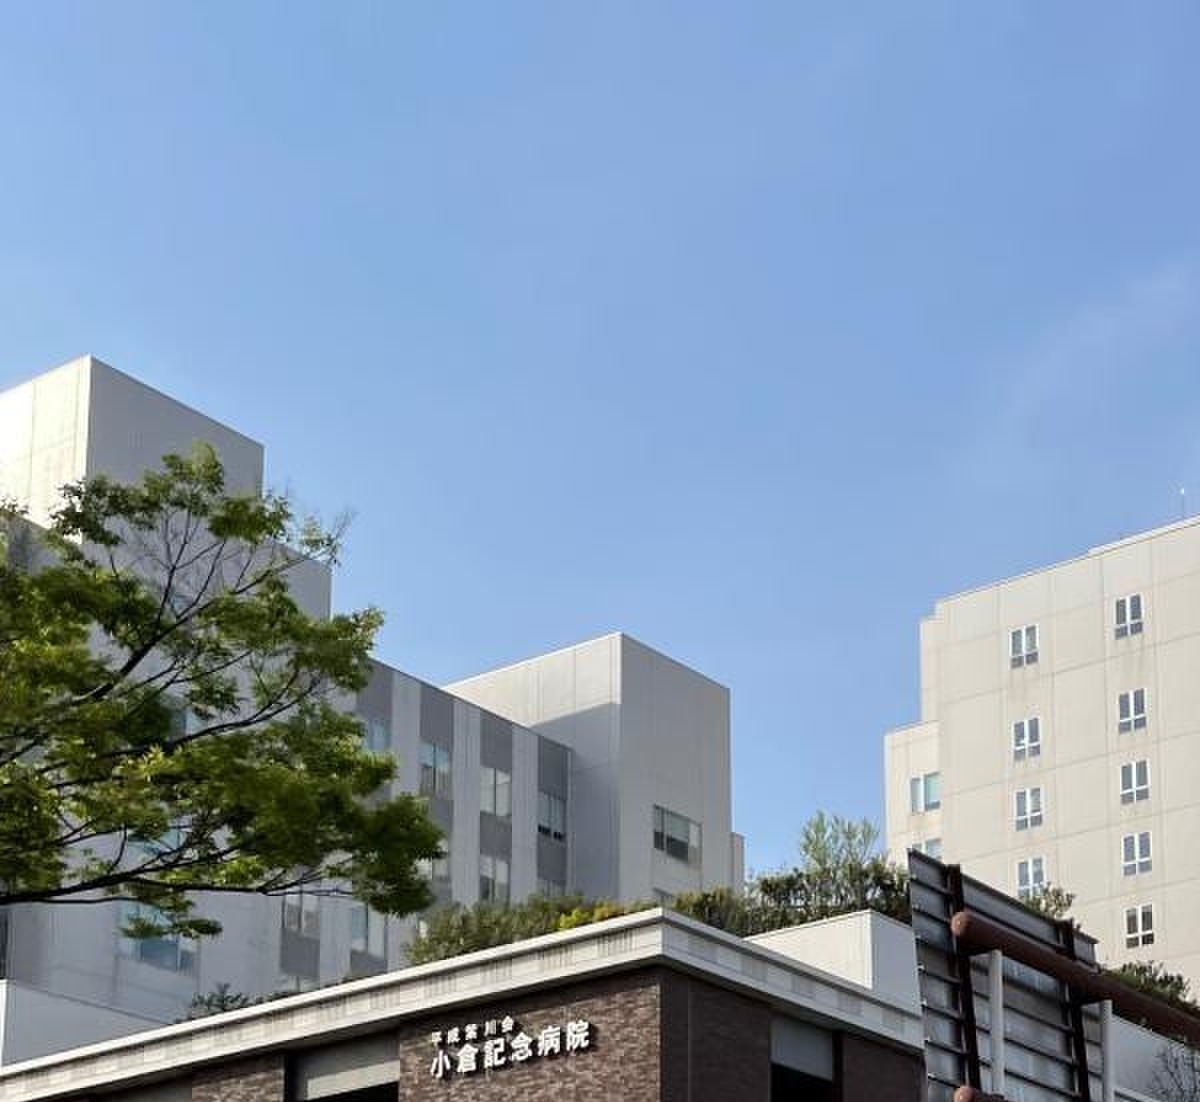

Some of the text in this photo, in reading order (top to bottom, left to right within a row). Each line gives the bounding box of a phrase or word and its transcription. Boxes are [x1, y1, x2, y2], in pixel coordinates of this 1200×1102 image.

[430, 1019, 590, 1078] 小倉記念病院
